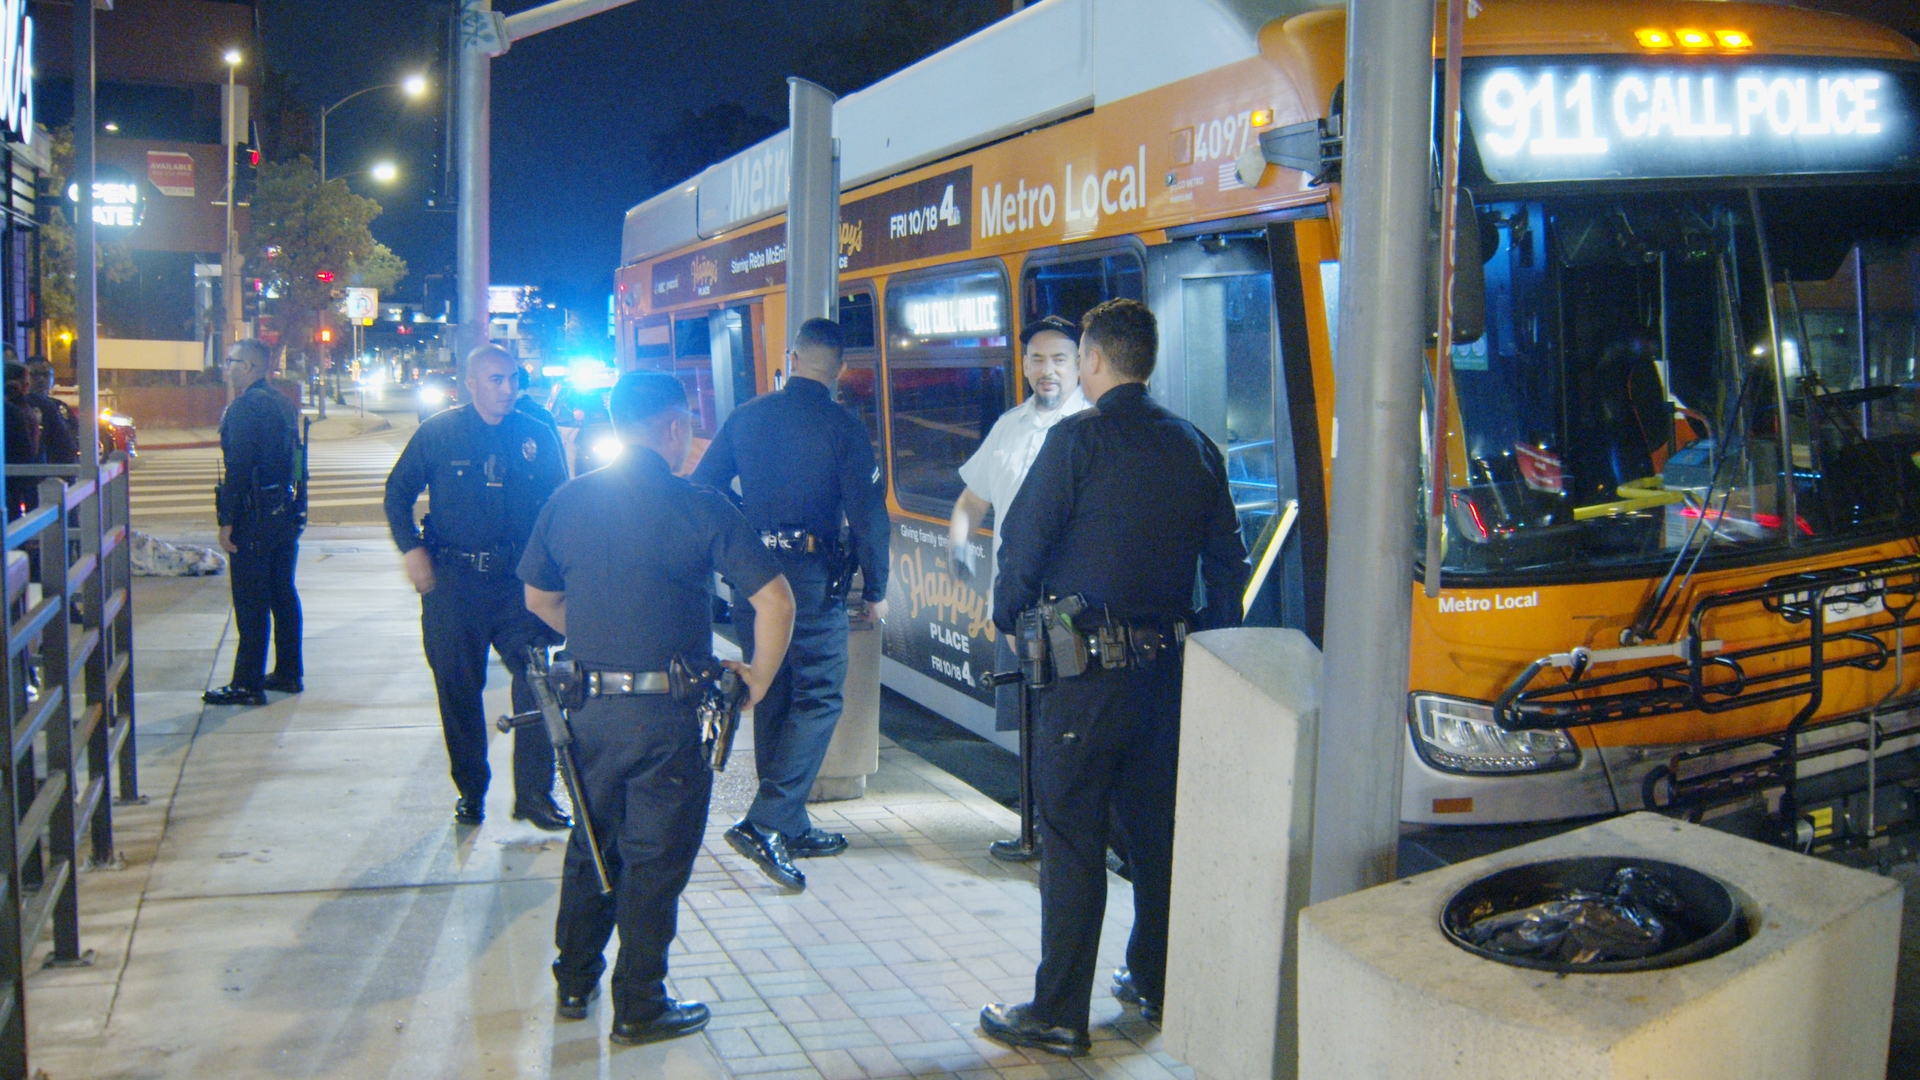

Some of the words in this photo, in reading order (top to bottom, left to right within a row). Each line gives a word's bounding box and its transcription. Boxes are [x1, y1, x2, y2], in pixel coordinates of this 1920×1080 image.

[1483, 72, 1608, 155] 911
[1614, 76, 1732, 138] CALL
[1737, 77, 1881, 136] POLICE
[1195, 109, 1251, 162] 4097
[150, 162, 193, 172] AVAILABLE
[730, 148, 790, 223] Metr
[981, 182, 1055, 238] Metro
[1065, 144, 1146, 222] Local
[890, 213, 907, 240] FRI
[908, 204, 938, 236] 10/18
[940, 184, 957, 227] 4
[749, 251, 765, 270] Reba
[913, 303, 931, 334] 911
[932, 300, 957, 333] CALL
[958, 294, 998, 332] POLICE
[900, 524, 919, 543] Giving
[919, 528, 937, 548] family
[1438, 597, 1491, 613] Metro
[1495, 591, 1539, 610] Local
[929, 622, 970, 654] PLACE
[931, 655, 943, 673] FRI
